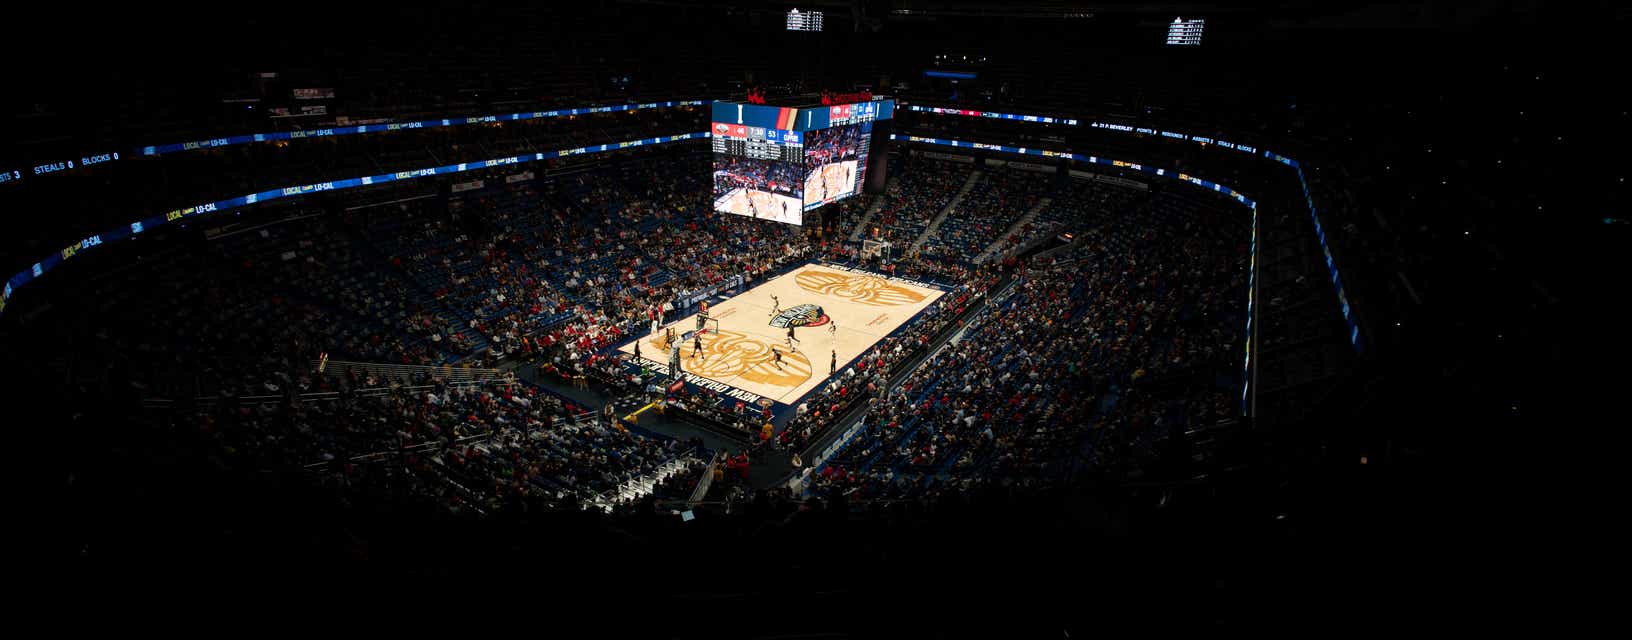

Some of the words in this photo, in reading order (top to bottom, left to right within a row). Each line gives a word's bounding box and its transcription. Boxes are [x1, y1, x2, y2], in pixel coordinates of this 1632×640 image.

[317, 129, 334, 137] LO-CAL
[768, 130, 776, 138] 53
[210, 138, 229, 147] LO-CAL
[13, 170, 21, 180] 3
[34, 162, 65, 175] STEALS
[67, 160, 74, 169] 0
[81, 153, 111, 166] BLOCKS
[113, 152, 119, 160] 0
[420, 168, 436, 176] LO-CAL
[283, 186, 301, 196] LOCAL
[314, 182, 334, 192] LO-CAL
[166, 209, 183, 222] LOCAL
[195, 202, 217, 214] LO-CAL
[81, 234, 103, 249] LO-CAL
[725, 388, 760, 403] NEW
